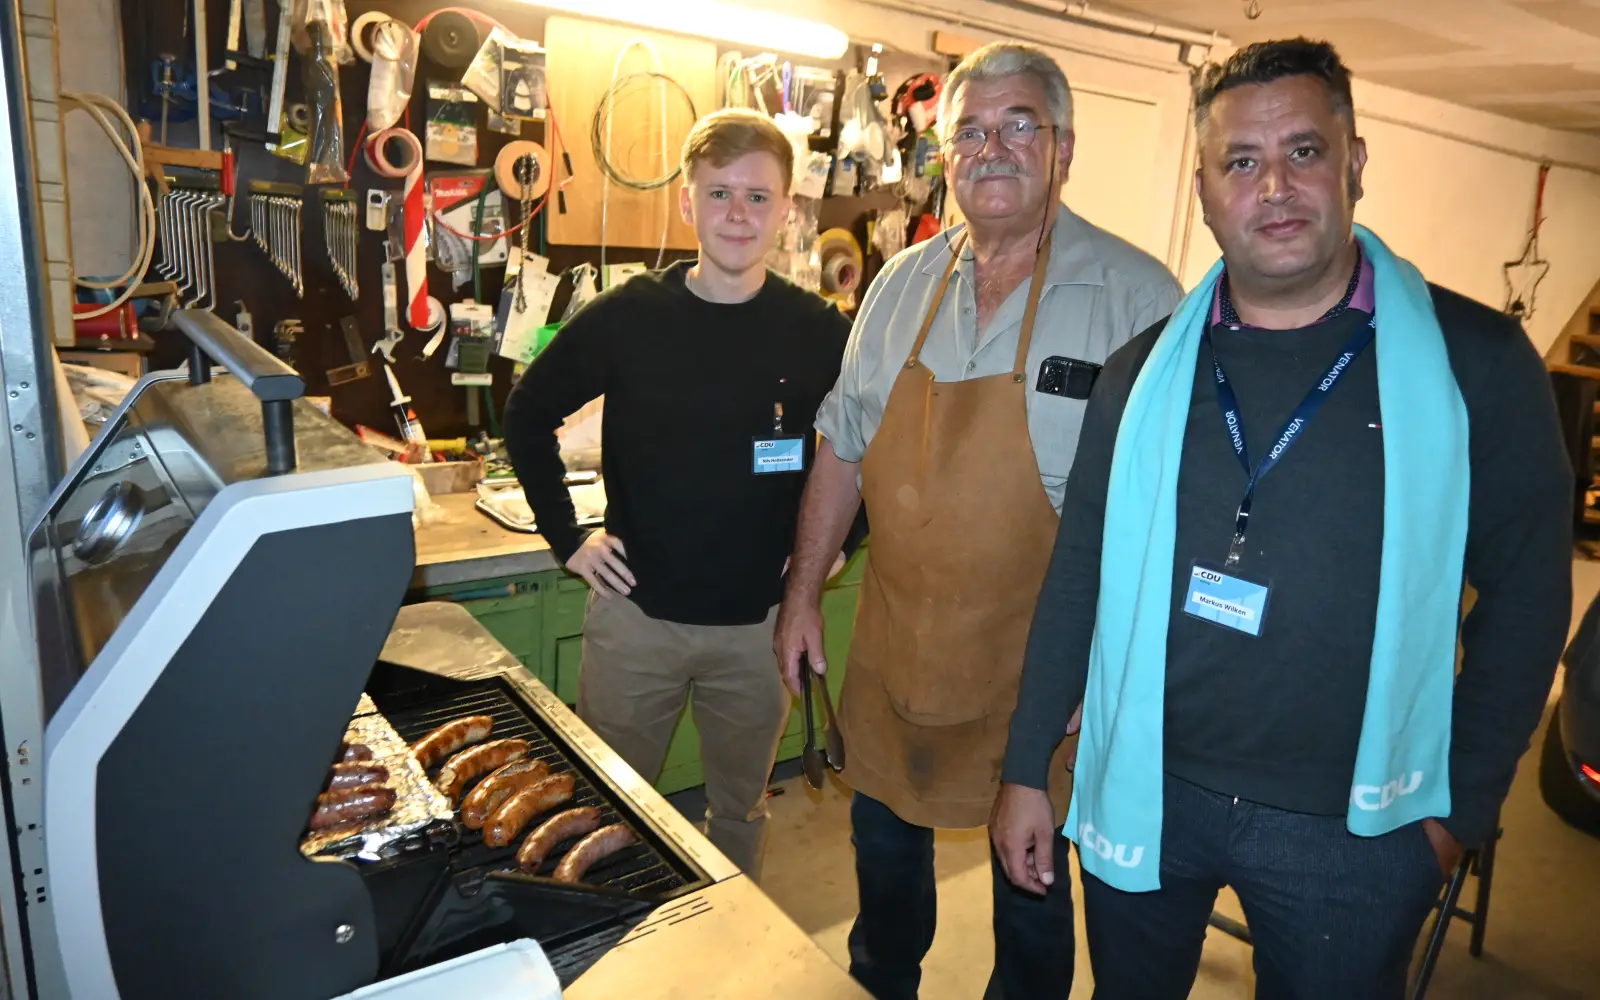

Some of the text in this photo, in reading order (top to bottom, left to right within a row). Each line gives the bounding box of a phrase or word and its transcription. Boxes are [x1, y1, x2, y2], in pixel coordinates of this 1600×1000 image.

[1317, 352, 1354, 392] VENATOR
[1225, 410, 1243, 455] VENATOR
[1269, 418, 1304, 460] VENATOR
[1201, 571, 1221, 582] CDU
[1199, 596, 1247, 616] Markus Wilken
[1353, 771, 1423, 811] CDU
[1080, 823, 1145, 868] CDU
